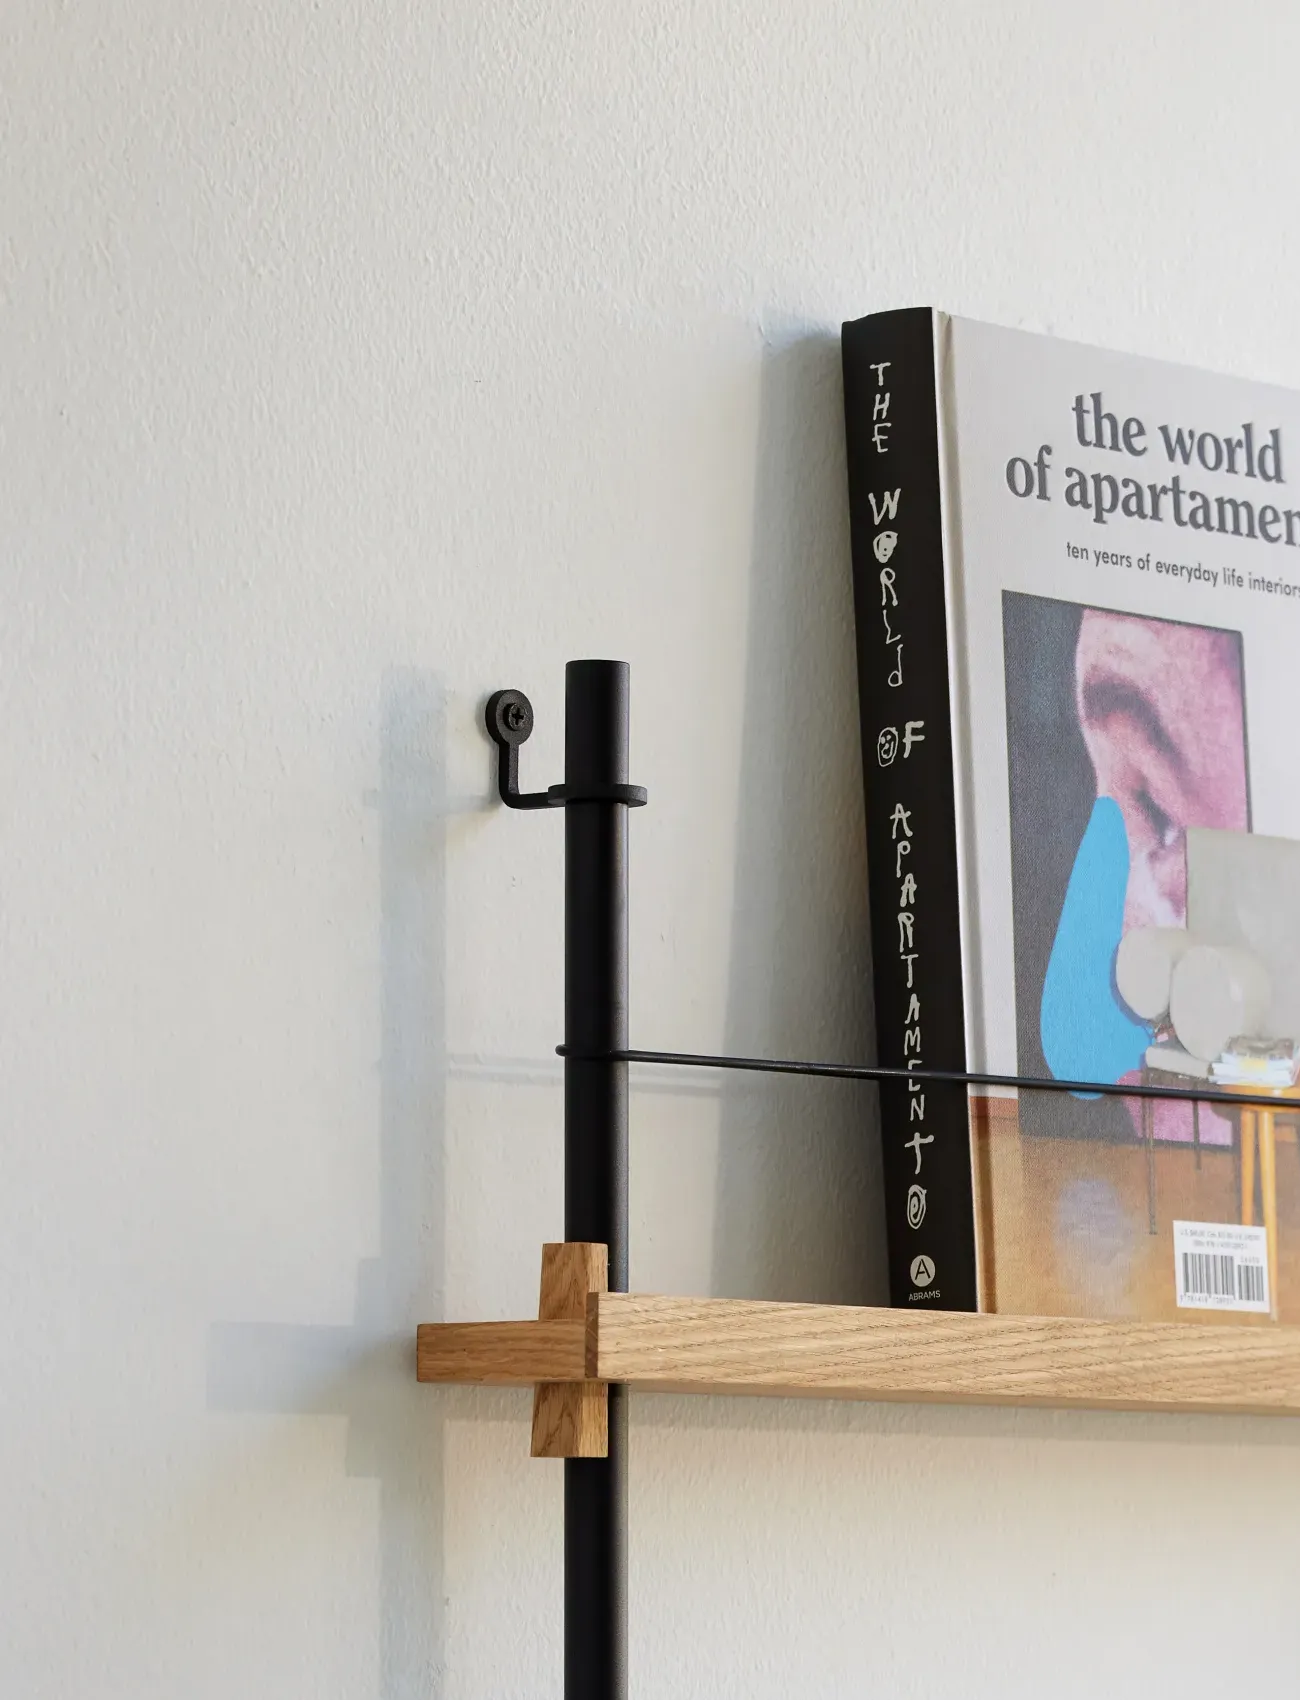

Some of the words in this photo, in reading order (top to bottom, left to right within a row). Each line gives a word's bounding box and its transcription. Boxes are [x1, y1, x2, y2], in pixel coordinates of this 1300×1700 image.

[869, 361, 892, 454] THE
[1071, 392, 1149, 458] the
[1158, 421, 1286, 485] world
[1005, 444, 1054, 502] of
[1065, 541, 1090, 561] ten
[1093, 549, 1133, 569] years
[1136, 552, 1151, 572] of
[1155, 559, 1219, 588] everyday
[1222, 567, 1244, 589] life
[908, 1289, 941, 1302] ABRAMS
